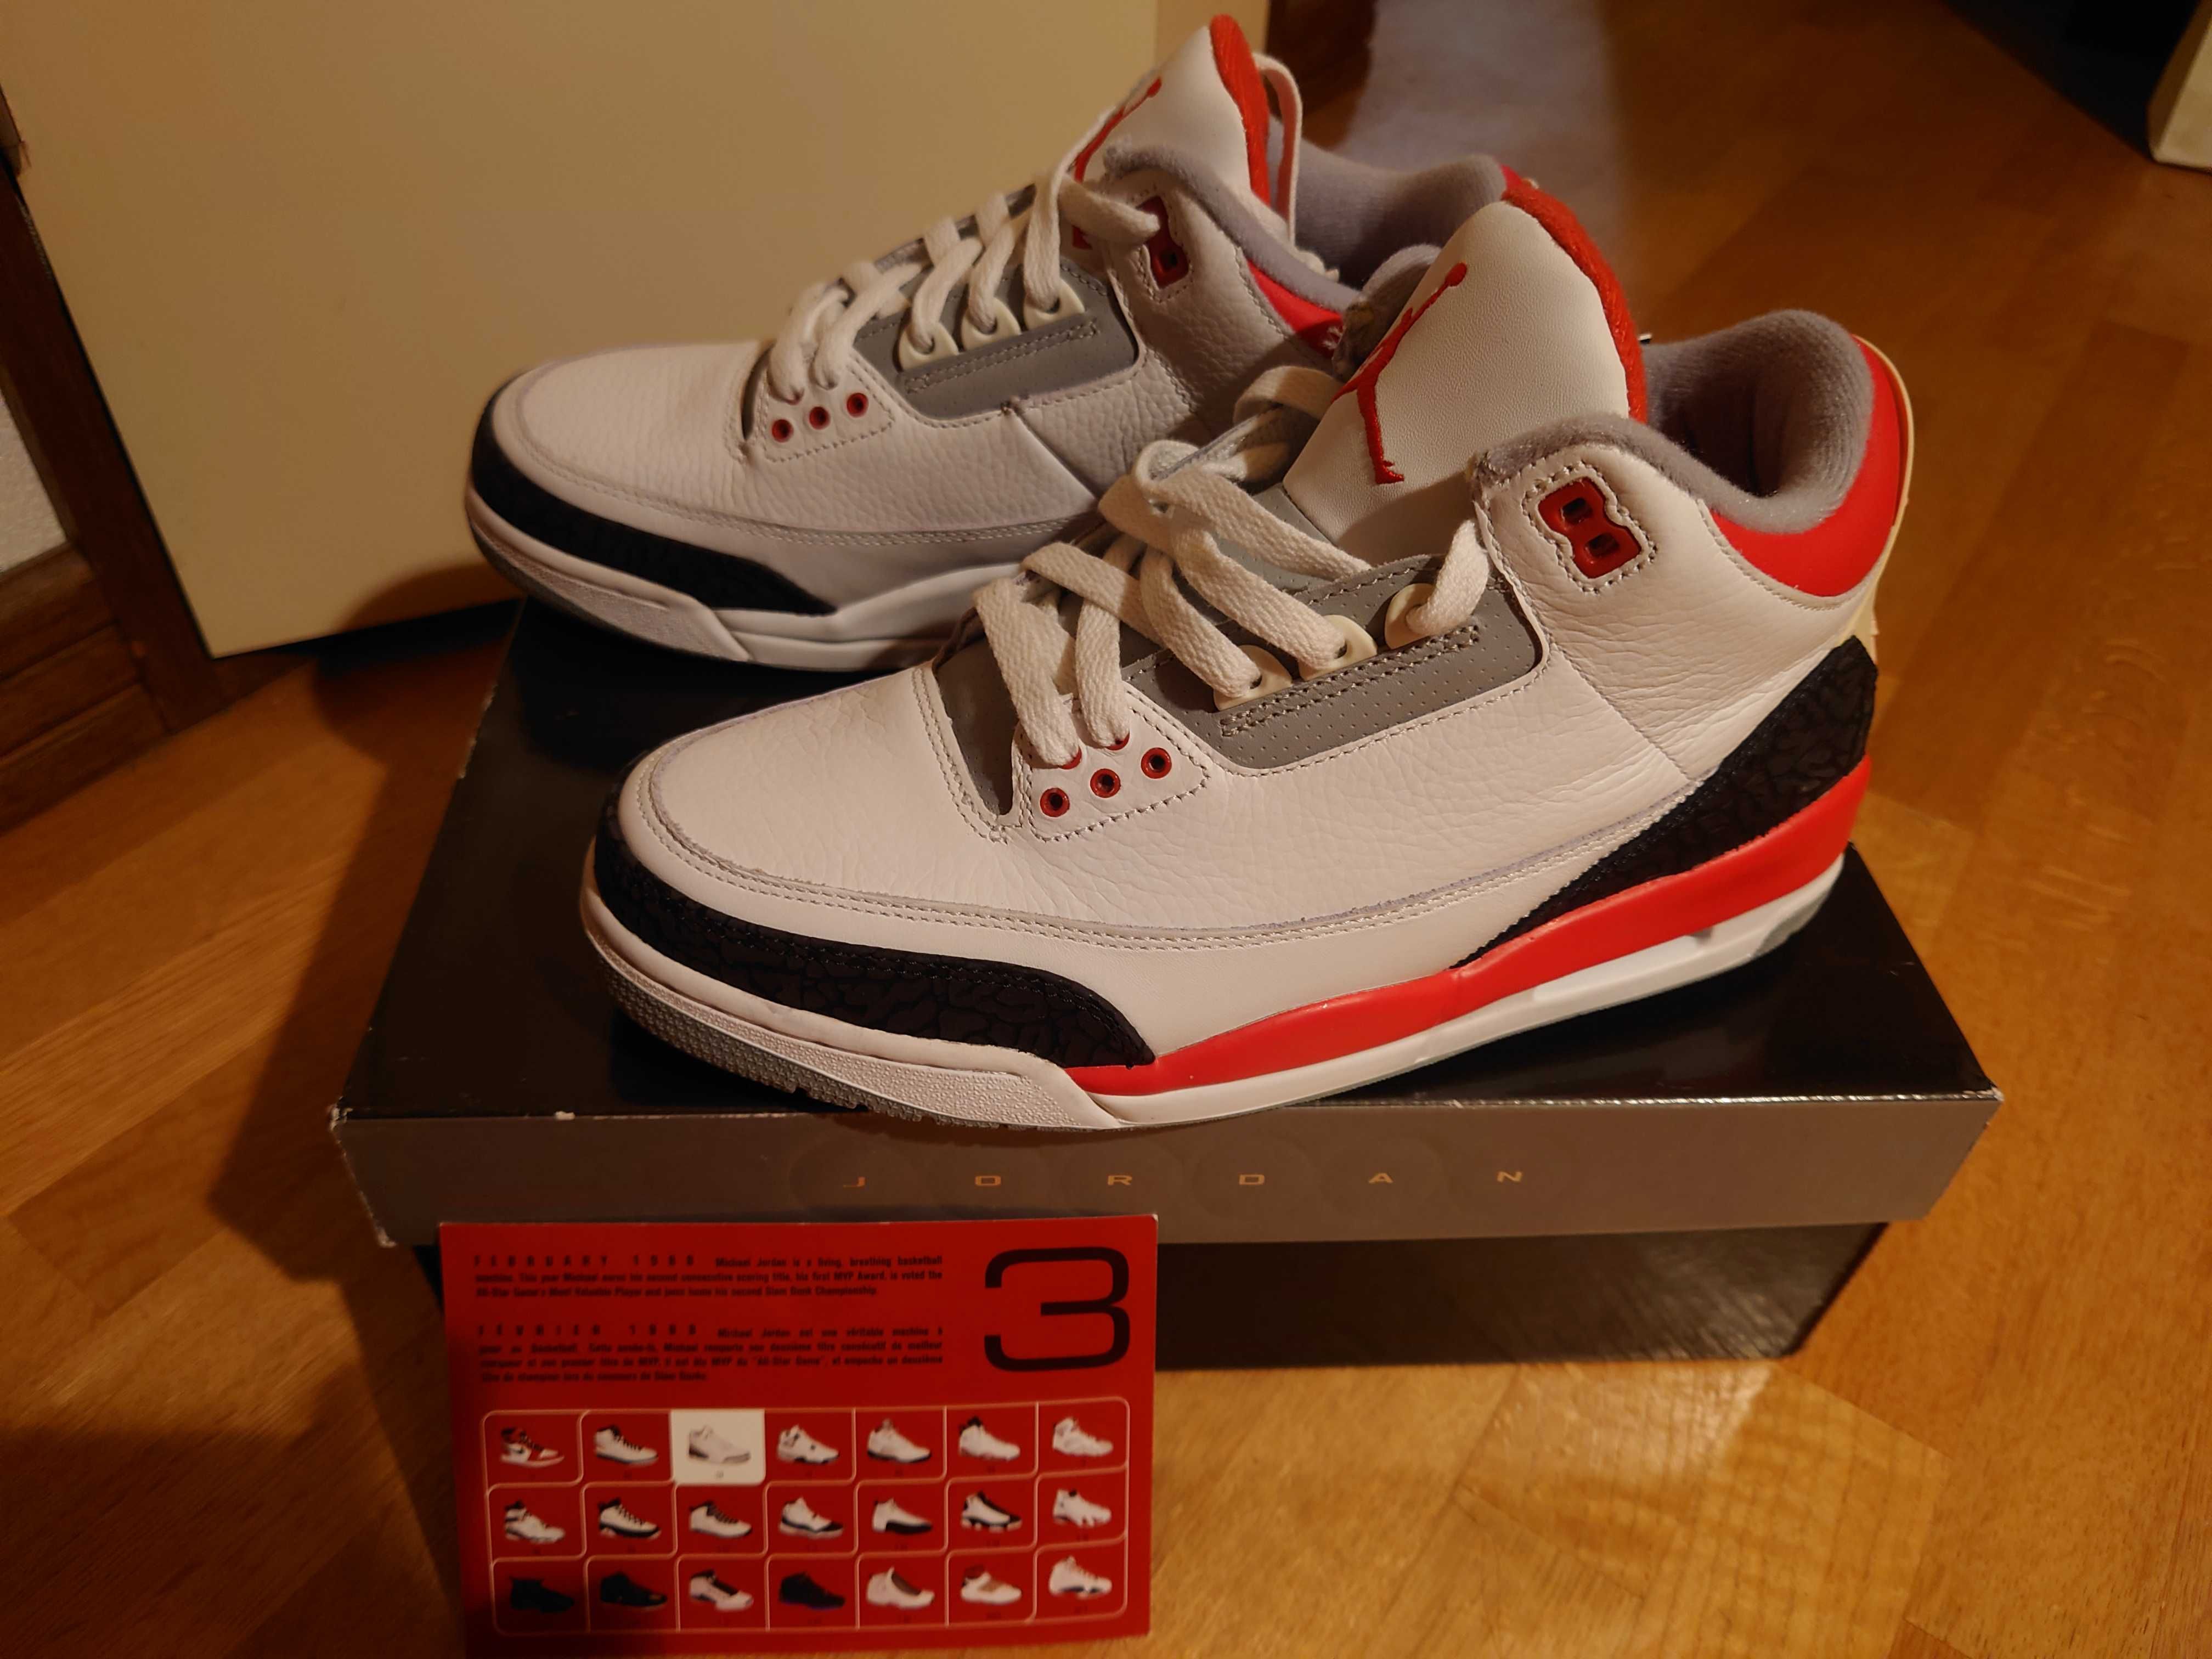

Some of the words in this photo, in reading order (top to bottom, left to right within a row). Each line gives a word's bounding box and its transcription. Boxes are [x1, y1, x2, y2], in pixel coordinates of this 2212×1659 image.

[843, 1171, 1522, 1188] JORDAN
[473, 1255, 608, 1267] FEBRUARY
[633, 1255, 695, 1266] 1988
[898, 1255, 943, 1266] basketball
[833, 1271, 854, 1280] MVP
[985, 1246, 1130, 1372] 3
